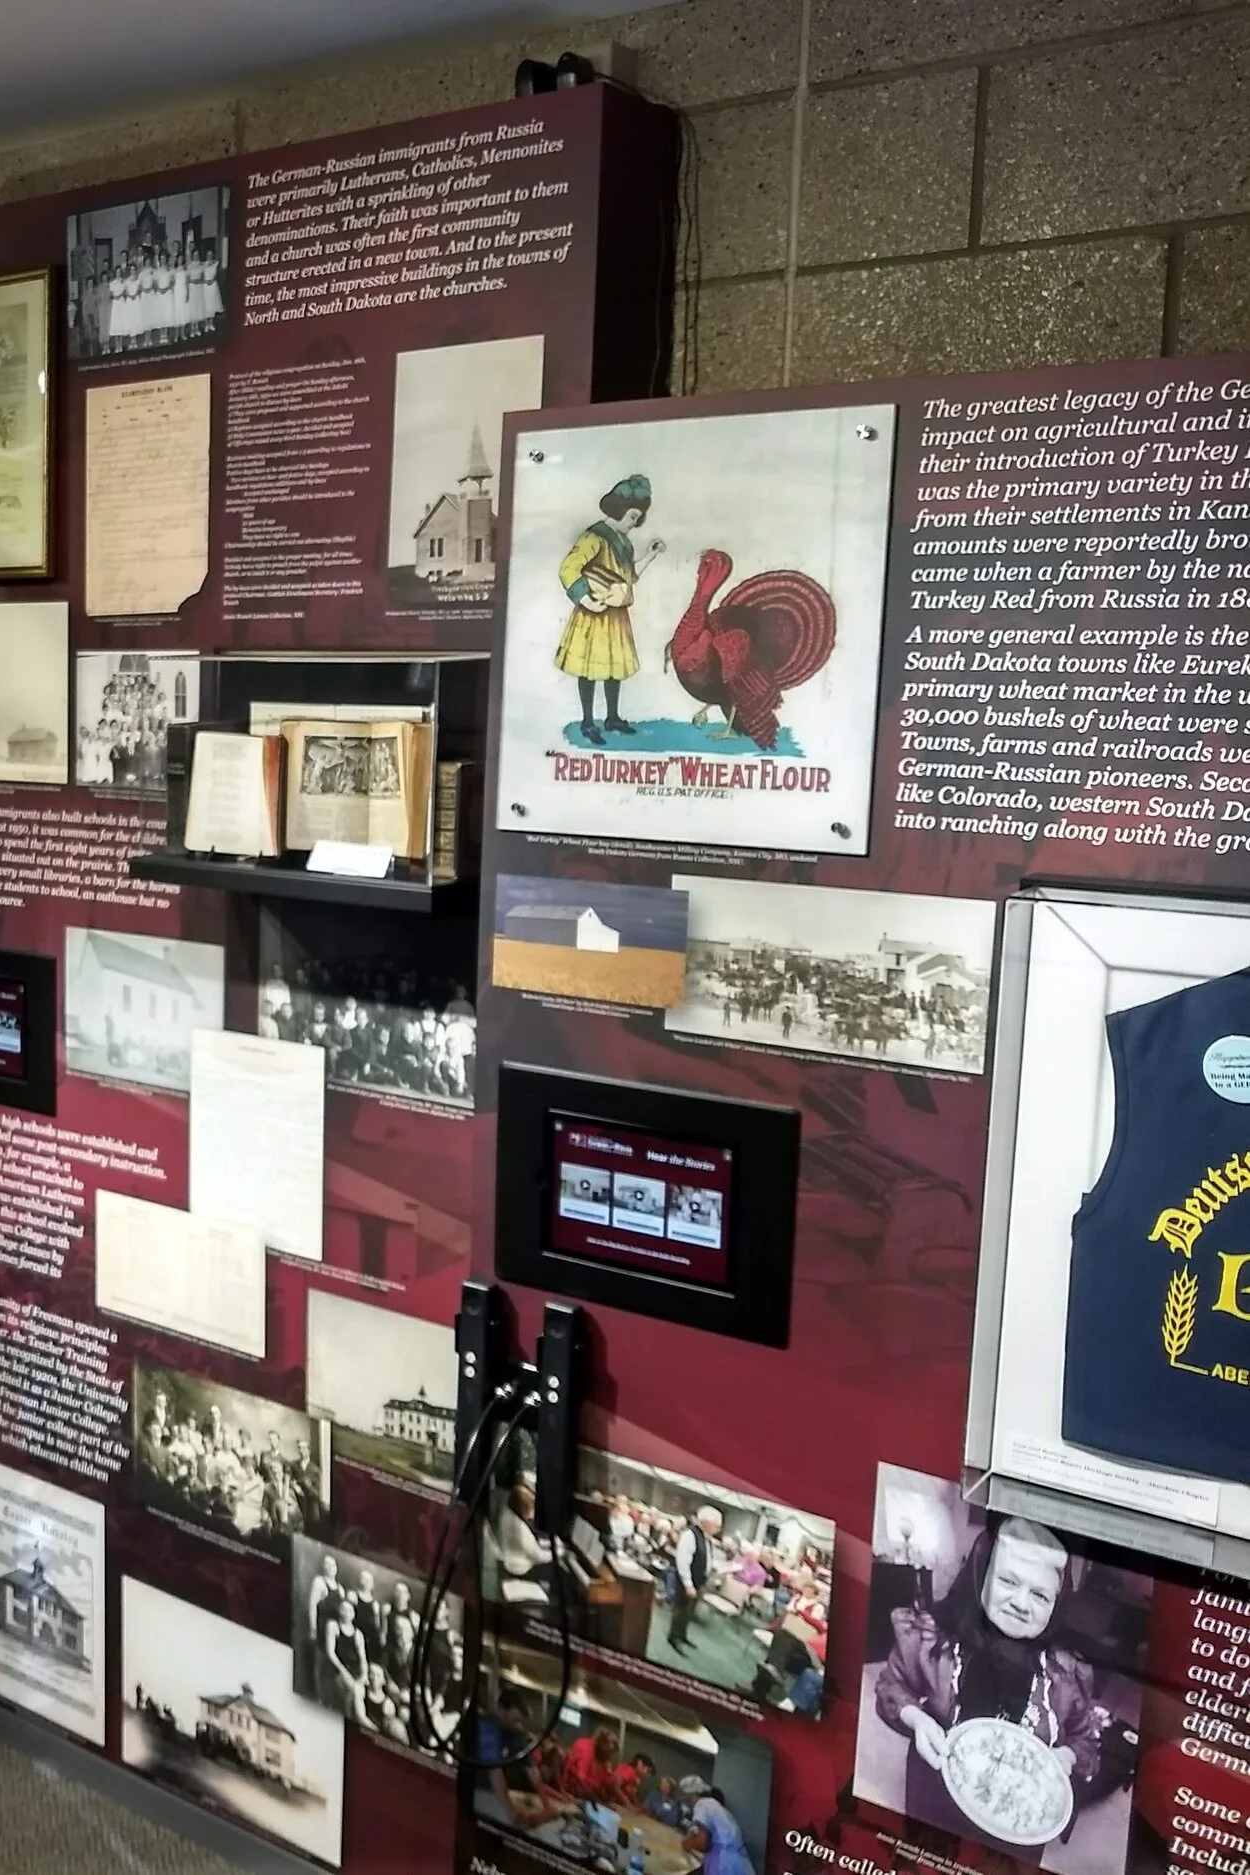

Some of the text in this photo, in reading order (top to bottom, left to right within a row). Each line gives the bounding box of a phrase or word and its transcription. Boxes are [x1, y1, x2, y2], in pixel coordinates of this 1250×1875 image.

[248, 120, 543, 189] The German-Russian immigrants from Russia
[246, 140, 563, 208] were primarily Lutherans, Catholics, Mennonites
[245, 182, 568, 247] denominations. Their faith was important to them
[245, 212, 519, 267] and a church was often the first community
[243, 276, 506, 325] North and South Dakota are the churches.
[924, 381, 1213, 422] The greatest legacy of the
[920, 410, 1232, 450] impact on agricultural and
[919, 441, 1237, 474] their introduction of Turkey
[917, 471, 1222, 503] was the primary variety in
[911, 501, 1190, 534] from their settlements in
[911, 560, 1219, 587] came when a farmer by the
[911, 589, 1209, 615] Turkey Red from Russia in
[906, 624, 1248, 651] A more general example is the
[904, 651, 1174, 675] South Dakota towns like
[899, 708, 1240, 736] 30,000 bushels of wheat were
[680, 757, 758, 789] WHEAT
[759, 760, 831, 792] FLOUR
[897, 756, 1193, 791] German-Russian pioneers.
[893, 808, 1210, 849] into ranching along with the
[669, 1153, 684, 1166] the
[1191, 1636, 1215, 1658] to
[1188, 1664, 1236, 1692] and
[1174, 1785, 1241, 1824] Some
[785, 1830, 835, 1864] Often
